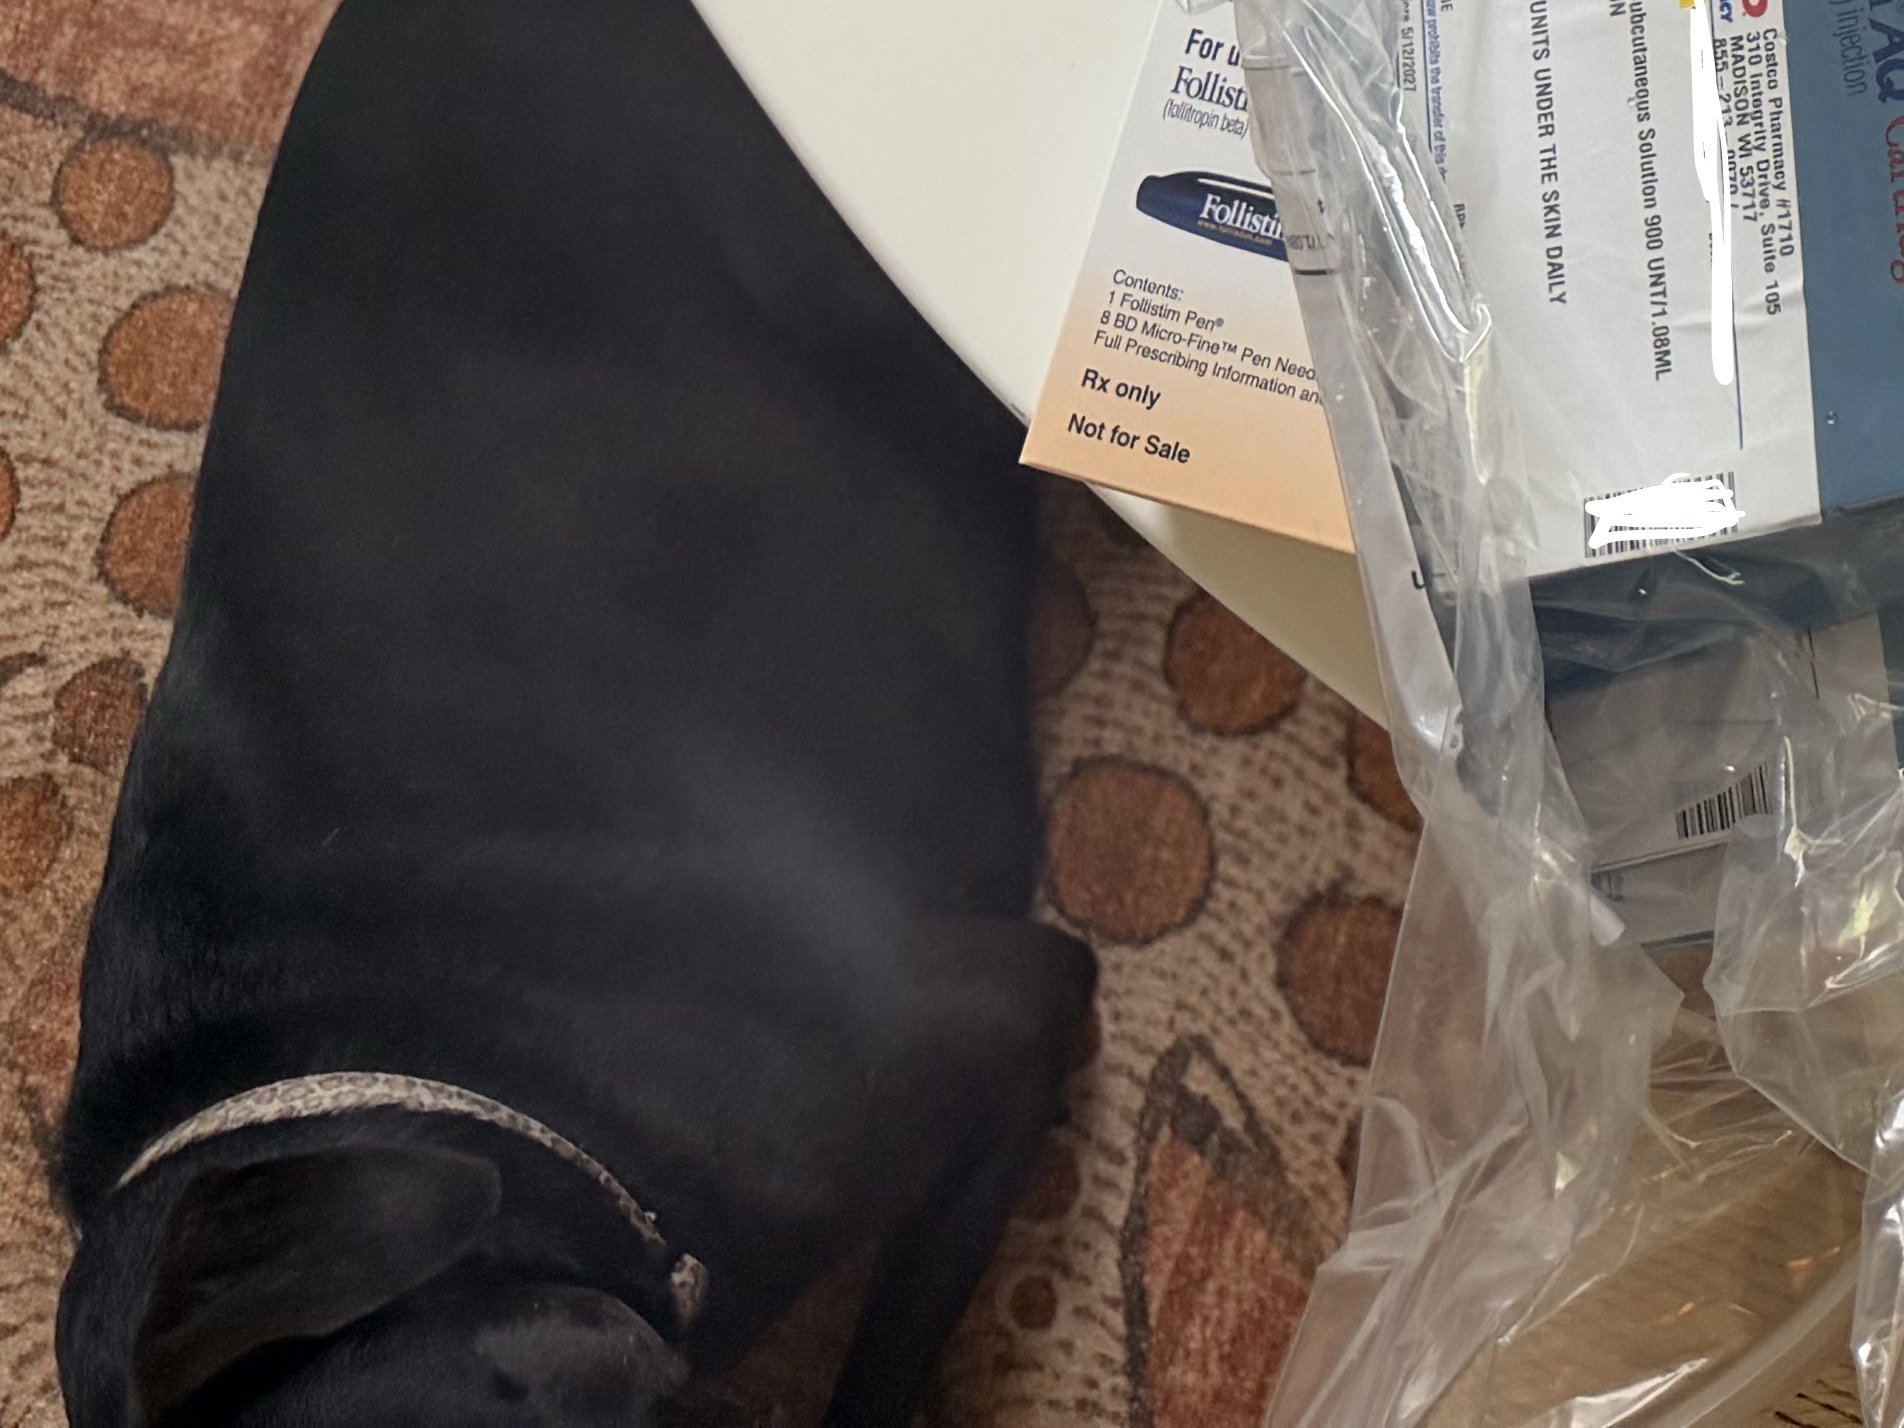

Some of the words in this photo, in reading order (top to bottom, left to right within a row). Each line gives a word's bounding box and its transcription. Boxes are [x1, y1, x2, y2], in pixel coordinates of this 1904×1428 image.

[1529, 0, 1551, 61] UNITS
[1533, 67, 1555, 138] UNDER
[1539, 143, 1559, 185] THE
[1541, 189, 1562, 239] SKIN
[1112, 269, 1185, 302] Contents:
[1545, 245, 1567, 304] DAILY
[1081, 367, 1111, 395] Rx
[1116, 378, 1162, 410] only
[1068, 413, 1108, 441] Not
[1111, 423, 1140, 450] for
[1144, 434, 1191, 465] Sale
